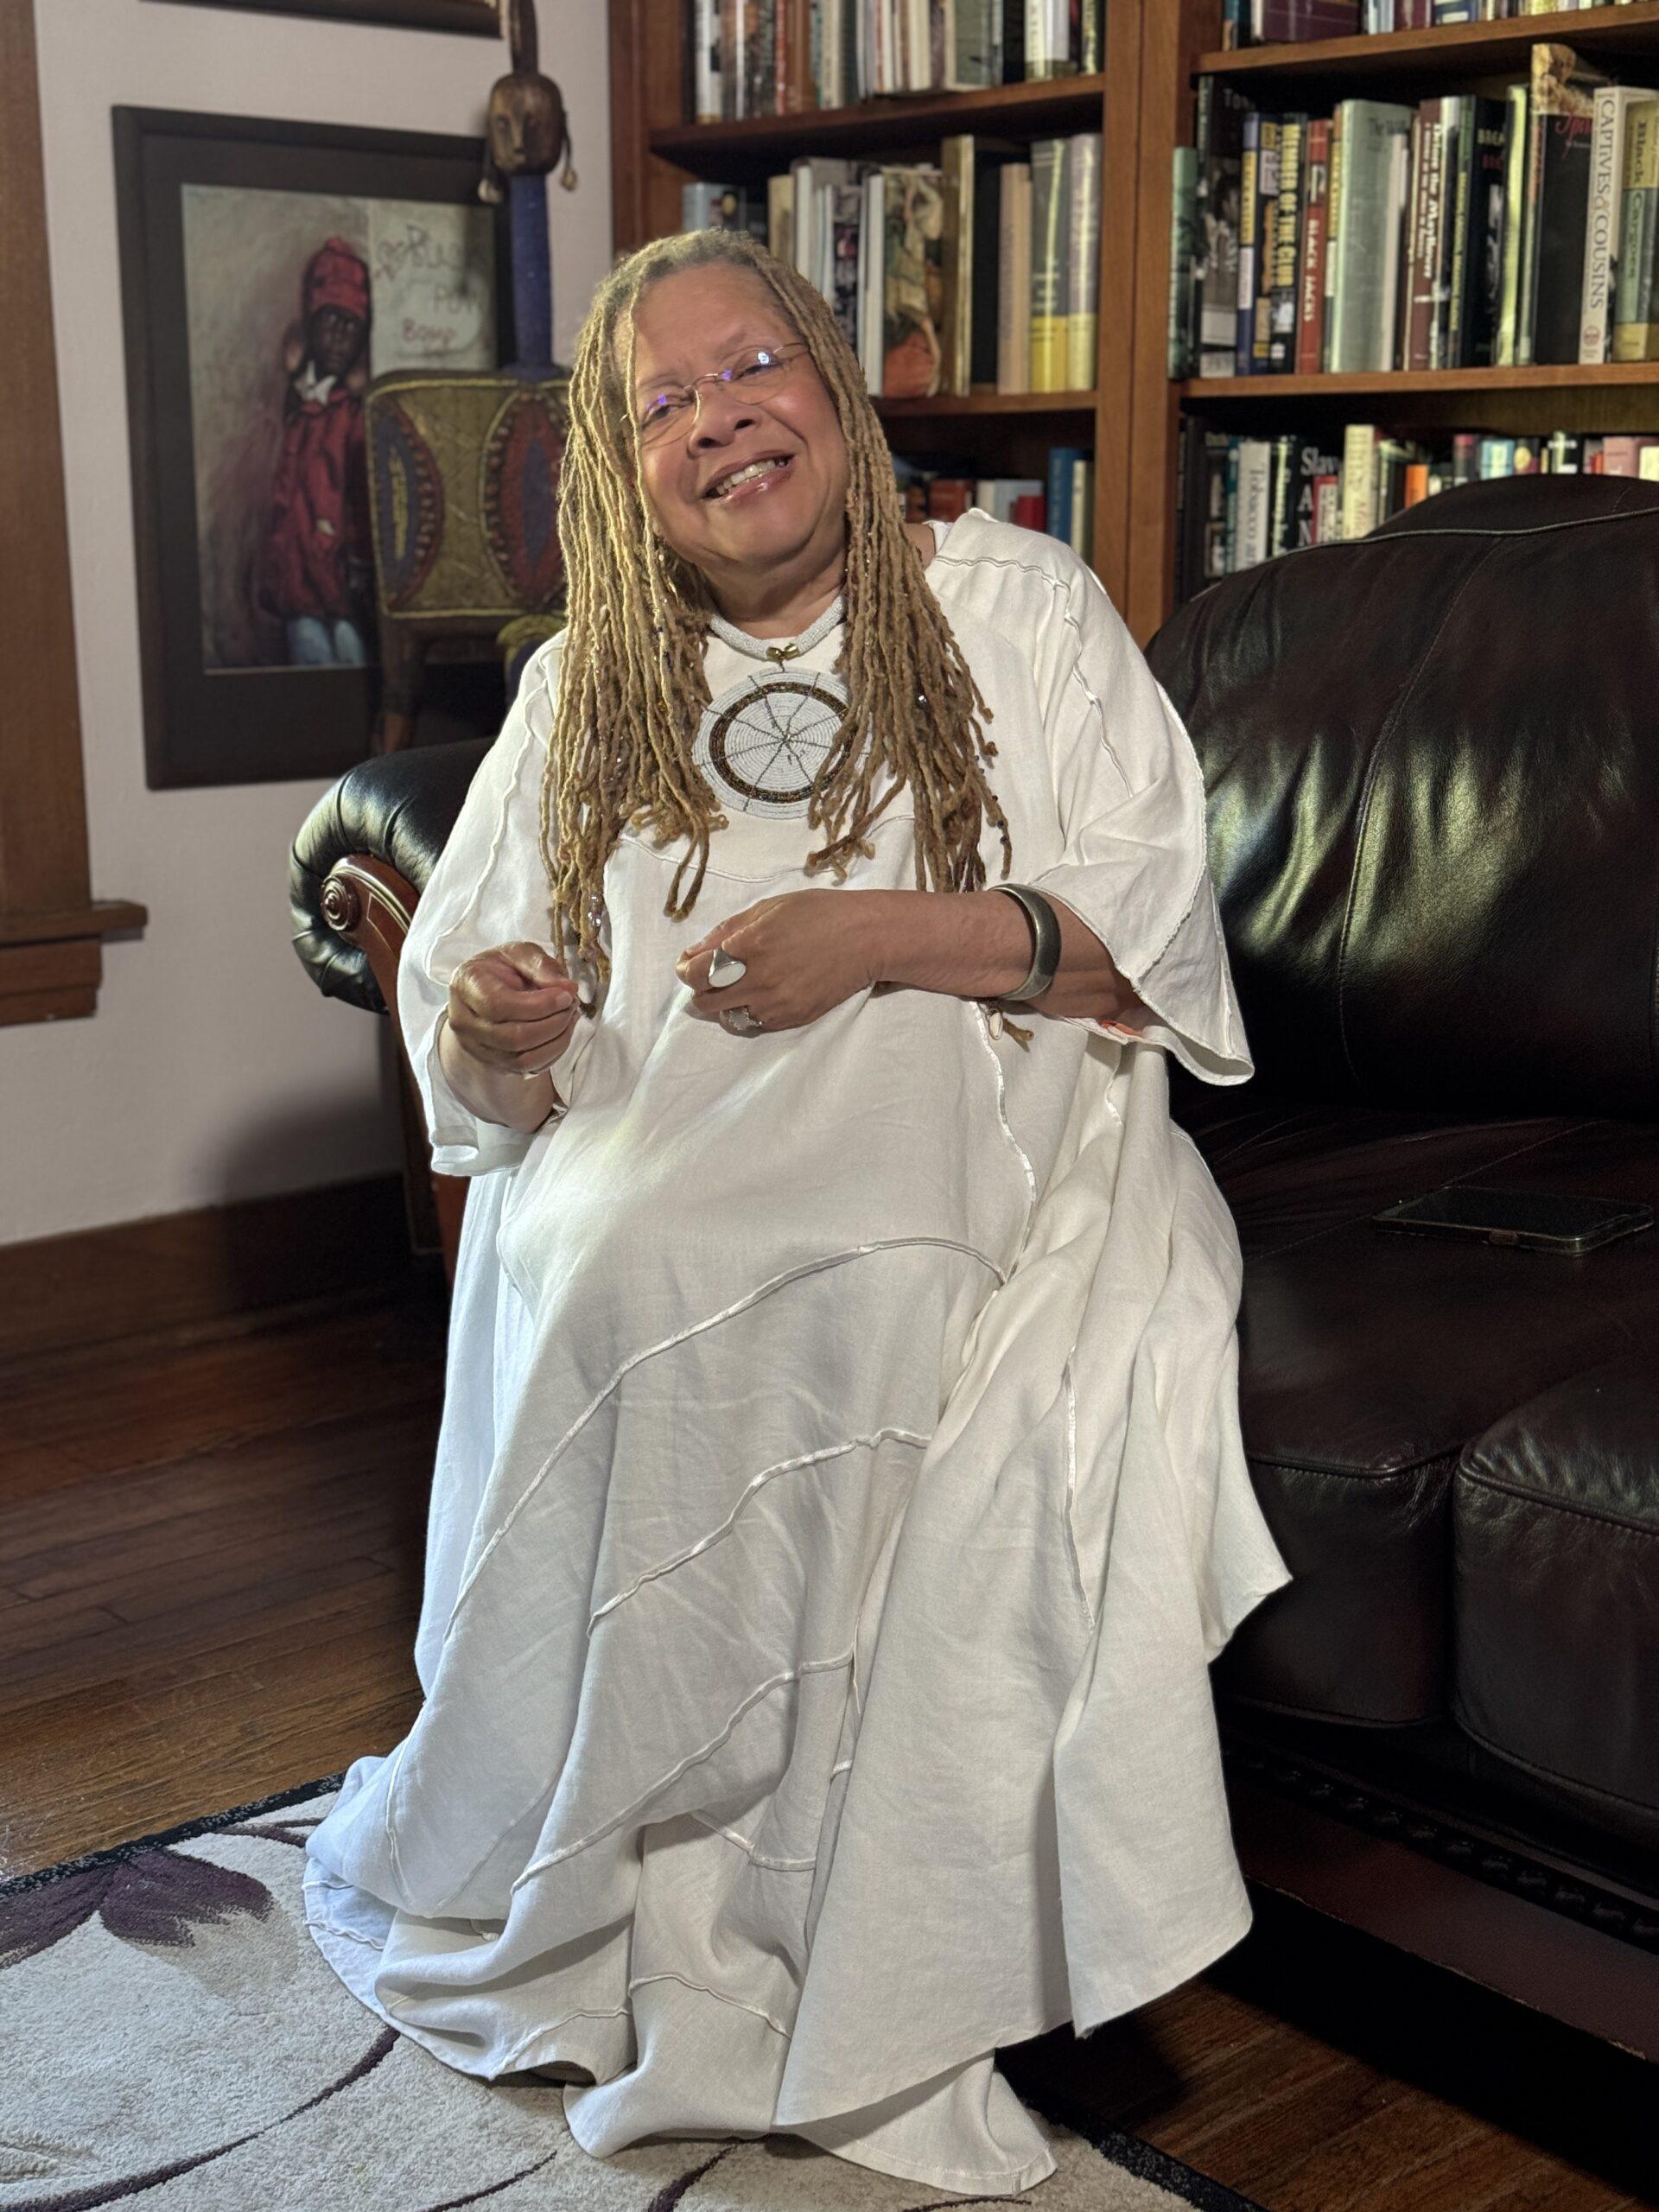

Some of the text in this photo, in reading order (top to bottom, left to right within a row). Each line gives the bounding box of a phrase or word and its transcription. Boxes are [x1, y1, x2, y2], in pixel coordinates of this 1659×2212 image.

[1428, 173, 1441, 194] the
[1597, 99, 1616, 194] CAPTIVES
[1276, 124, 1301, 287] MEMBER OF THE CLUB
[1422, 200, 1440, 278] Mayflower
[1627, 121, 1648, 280] Black Cargoes
[1304, 219, 1319, 322] BLACK JACKS
[1590, 214, 1610, 310] COUSINS
